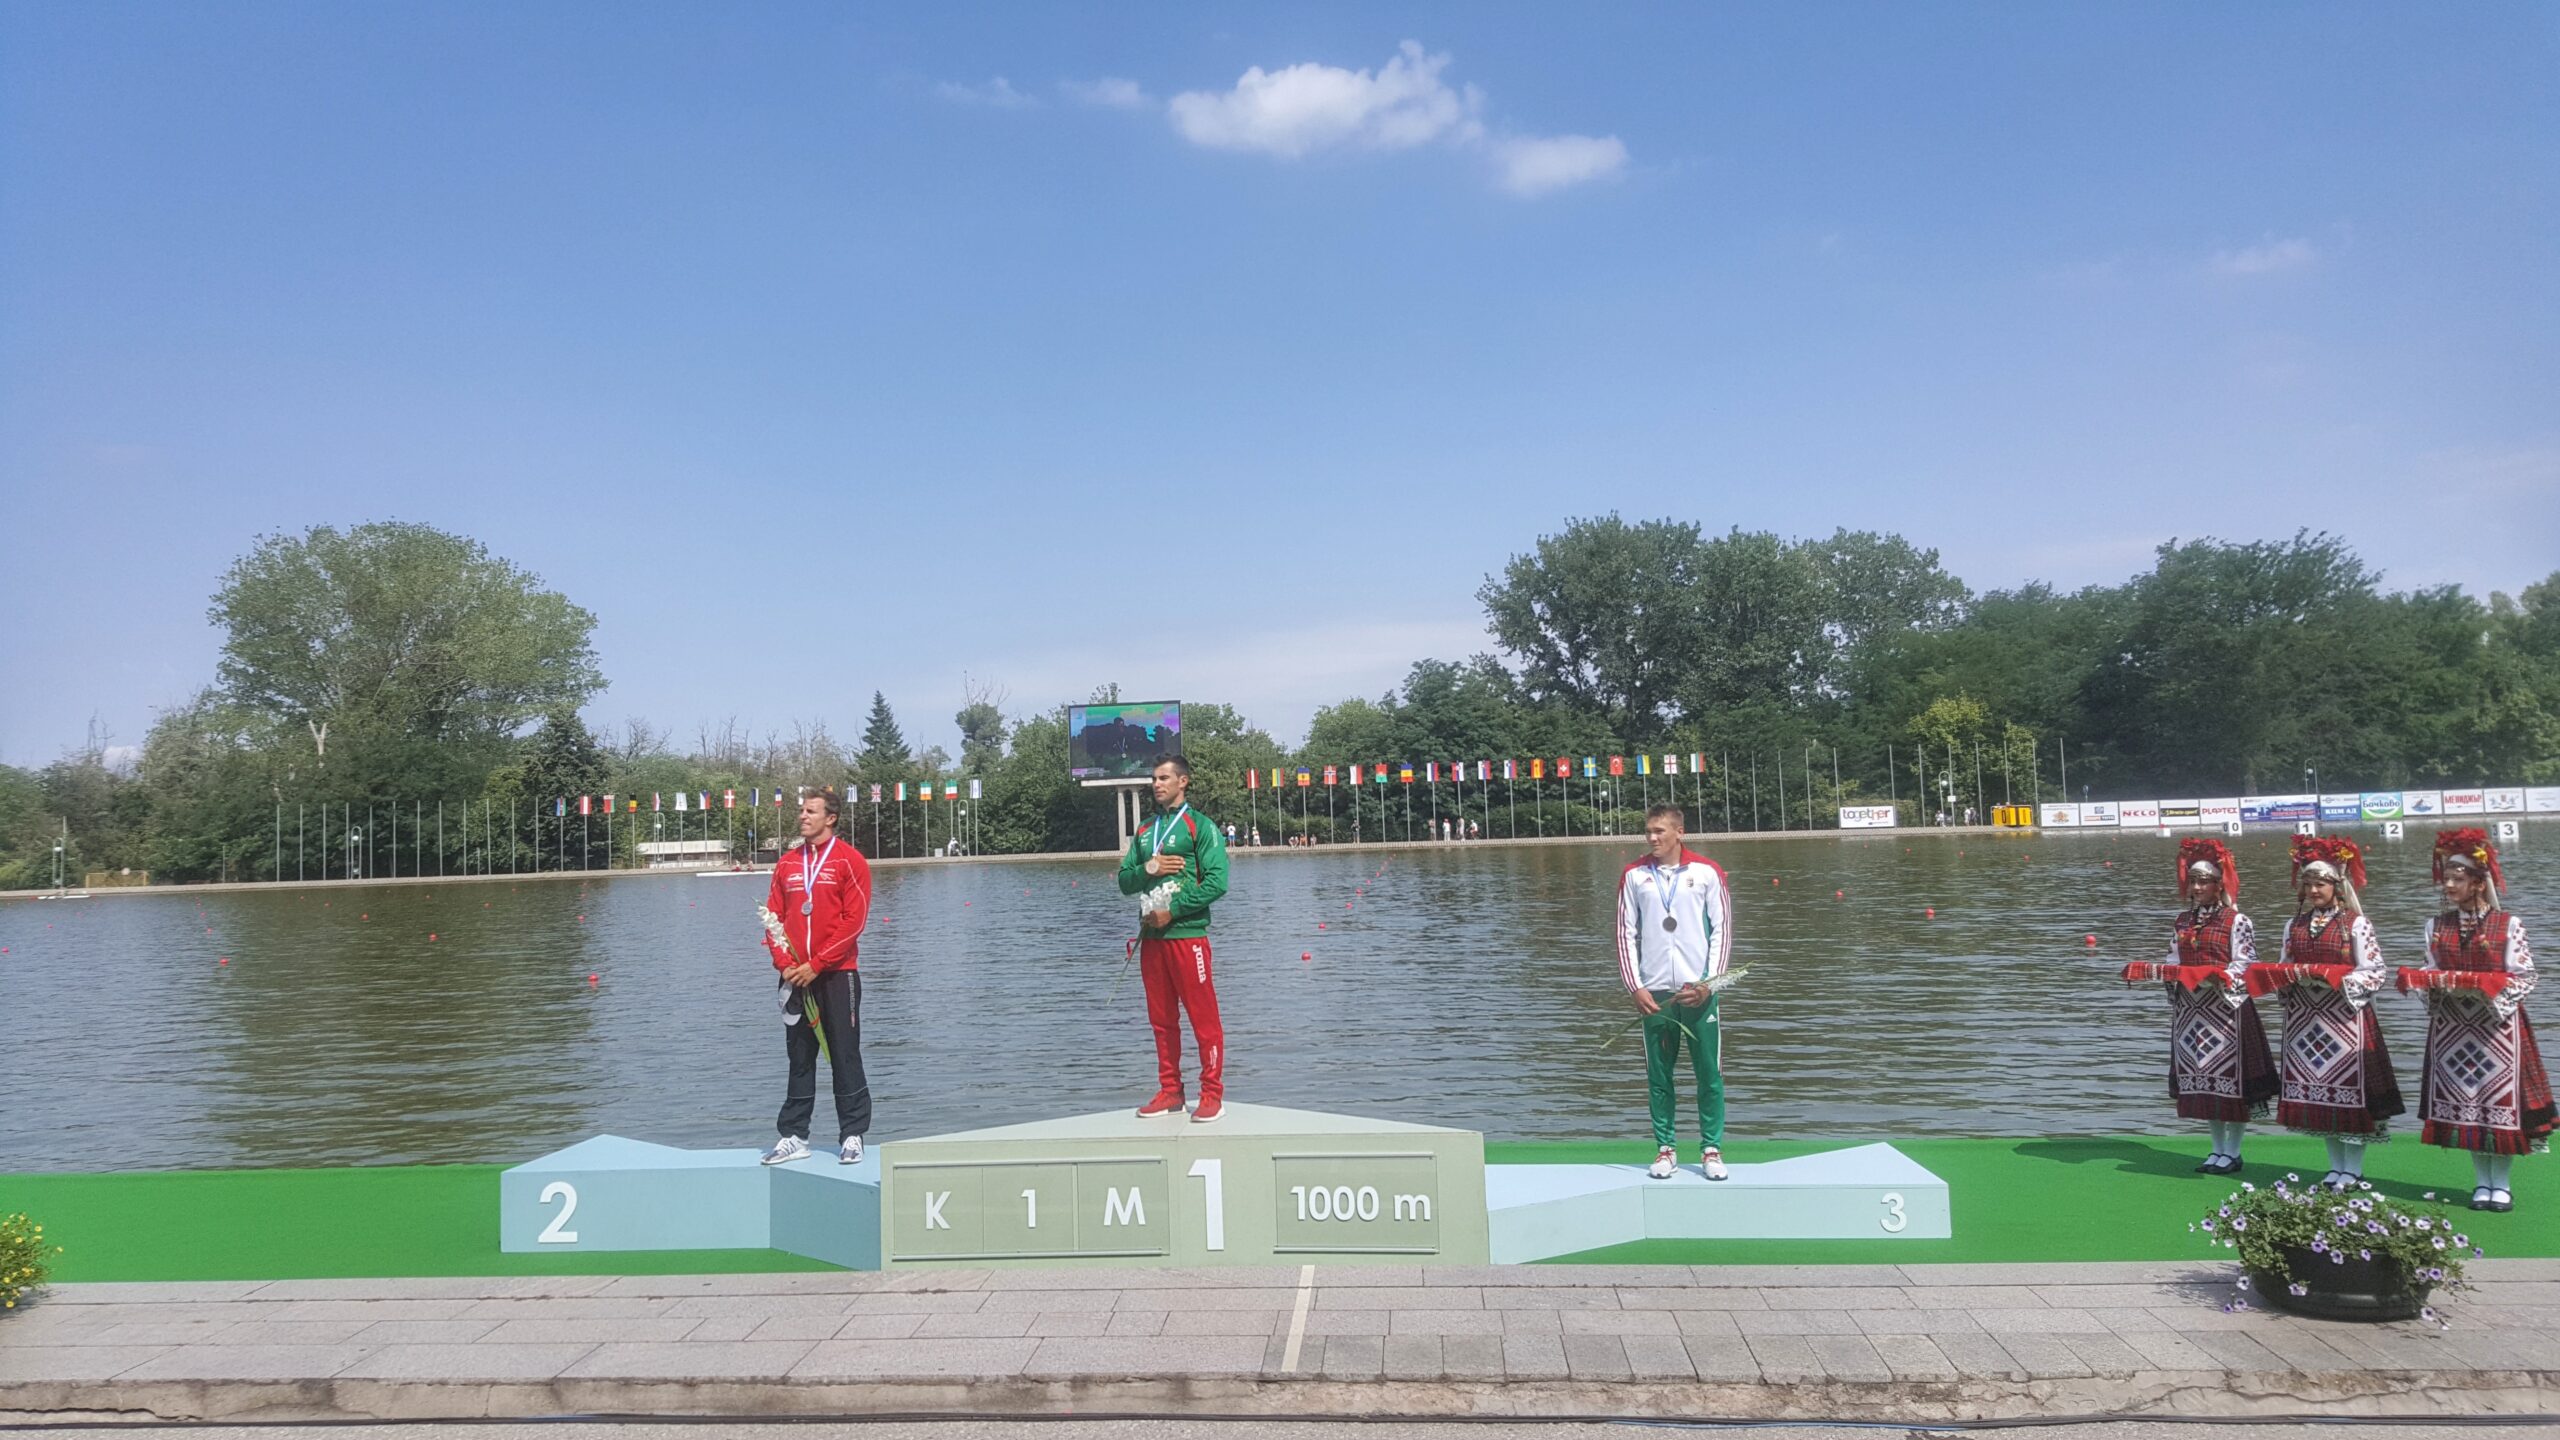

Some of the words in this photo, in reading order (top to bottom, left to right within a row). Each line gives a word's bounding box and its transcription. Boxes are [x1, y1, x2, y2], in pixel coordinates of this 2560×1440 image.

[2363, 798, 2401, 808] Бачково
[1842, 808, 1890, 822] together
[2232, 822, 2239, 831] 0
[2302, 823, 2309, 832] 1
[2389, 824, 2399, 834] 2
[2503, 823, 2514, 835] 3
[925, 1190, 951, 1230] K
[1020, 1188, 1037, 1228] 1
[1103, 1186, 1146, 1226] M
[1187, 1158, 1225, 1251] 1
[1290, 1185, 1379, 1221] 1000
[1392, 1192, 1432, 1221] m
[538, 1181, 579, 1244] 2
[1879, 1192, 1907, 1233] 3
